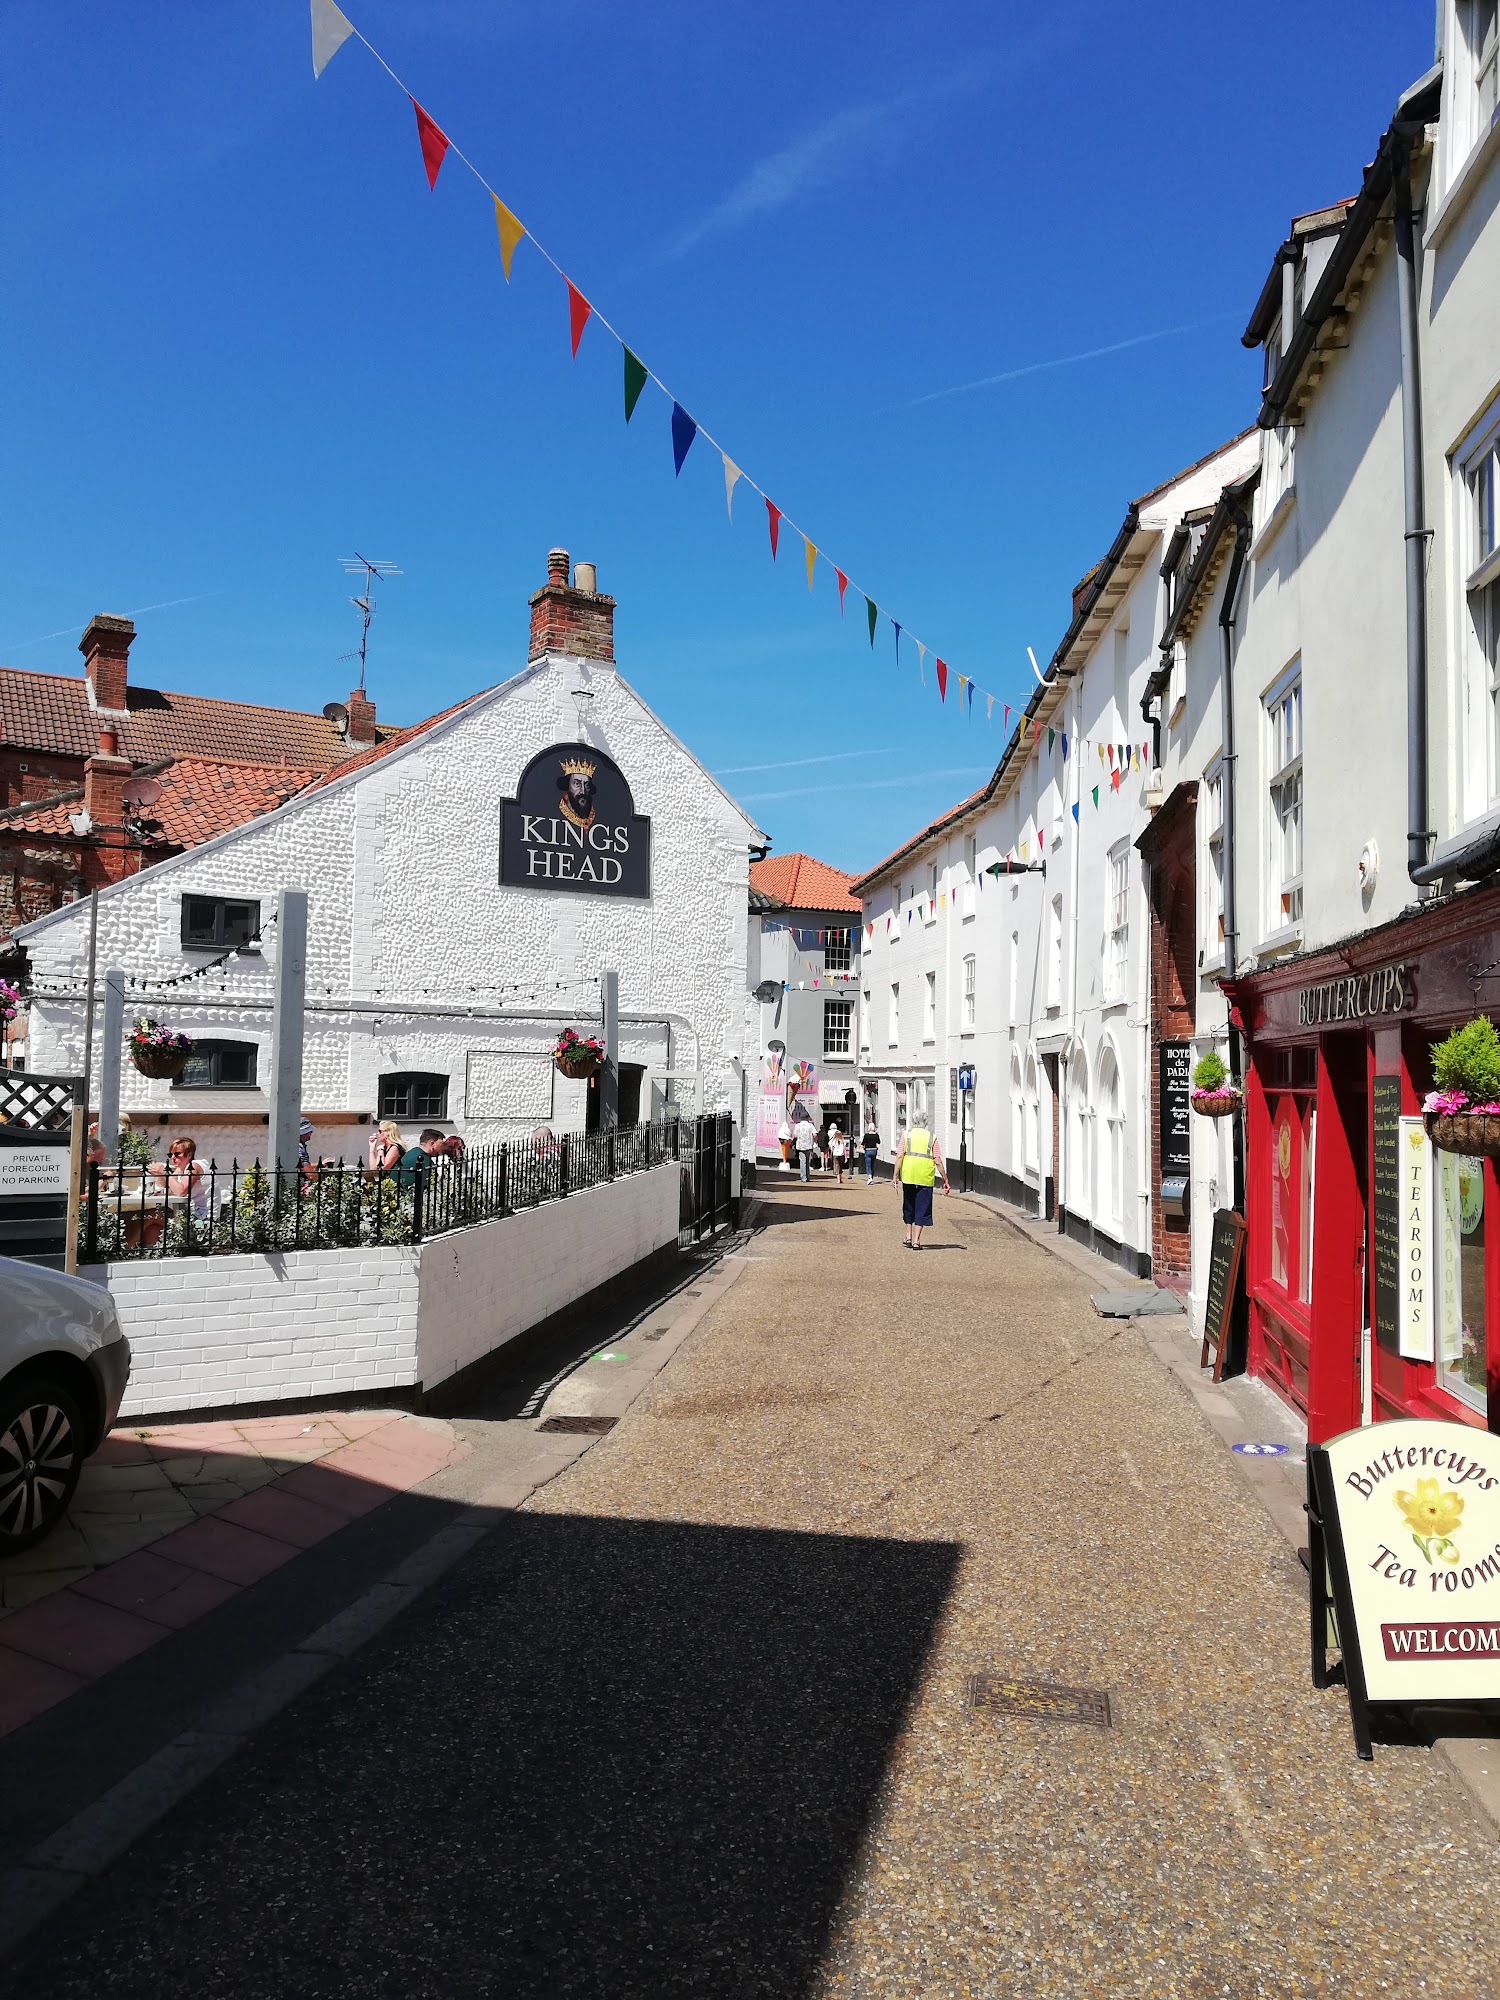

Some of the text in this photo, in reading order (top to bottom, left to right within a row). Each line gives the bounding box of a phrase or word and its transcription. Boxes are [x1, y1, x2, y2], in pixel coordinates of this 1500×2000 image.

[520, 814, 630, 854] KINGS
[526, 848, 623, 884] HEAD
[1298, 964, 1406, 1026] BUTTERCUPS
[1167, 1067, 1189, 1077] PARI
[1175, 1058, 1185, 1067] de
[2, 1164, 61, 1173] FORECOURT
[18, 1176, 60, 1184] PARKING
[1408, 1166, 1424, 1324] TEAROOMS
[1345, 1445, 1499, 1501] Buttercups
[1368, 1544, 1417, 1588] Tea
[1388, 1627, 1500, 1653] WELCOM
